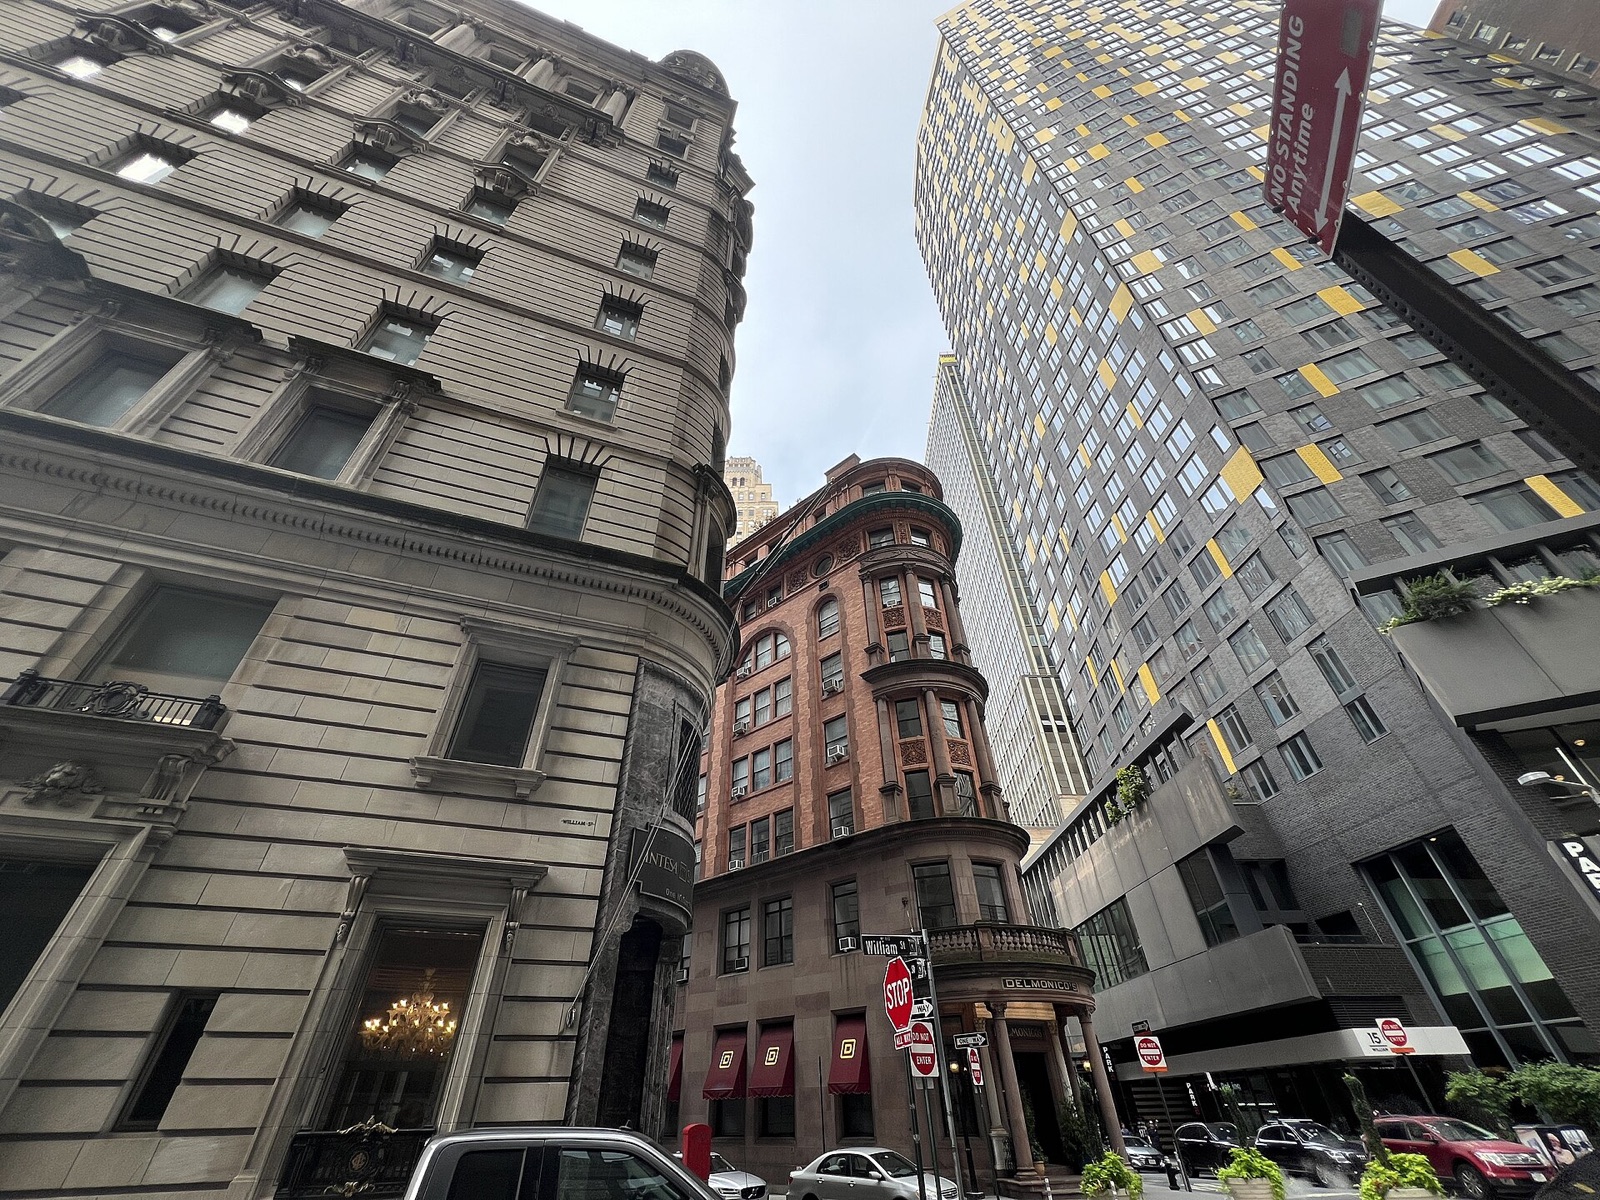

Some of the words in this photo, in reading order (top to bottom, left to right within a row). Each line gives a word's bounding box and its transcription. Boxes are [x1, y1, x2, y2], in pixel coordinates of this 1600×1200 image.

[1276, 15, 1304, 161] STANDING
[1287, 103, 1315, 214] Anytime
[1271, 164, 1286, 201] NO
[1562, 842, 1600, 893] PAR
[865, 940, 898, 955] William
[887, 978, 909, 1010] STOP
[1005, 979, 1078, 991] DELMONICO'S
[917, 1004, 929, 1013] WAY
[912, 1032, 919, 1040] DO
[920, 1032, 930, 1041] NOT
[1367, 1032, 1381, 1044] 15
[916, 1056, 932, 1065] ENTER
[1102, 1046, 1114, 1073] PARK
[1186, 1082, 1198, 1107] PARK
